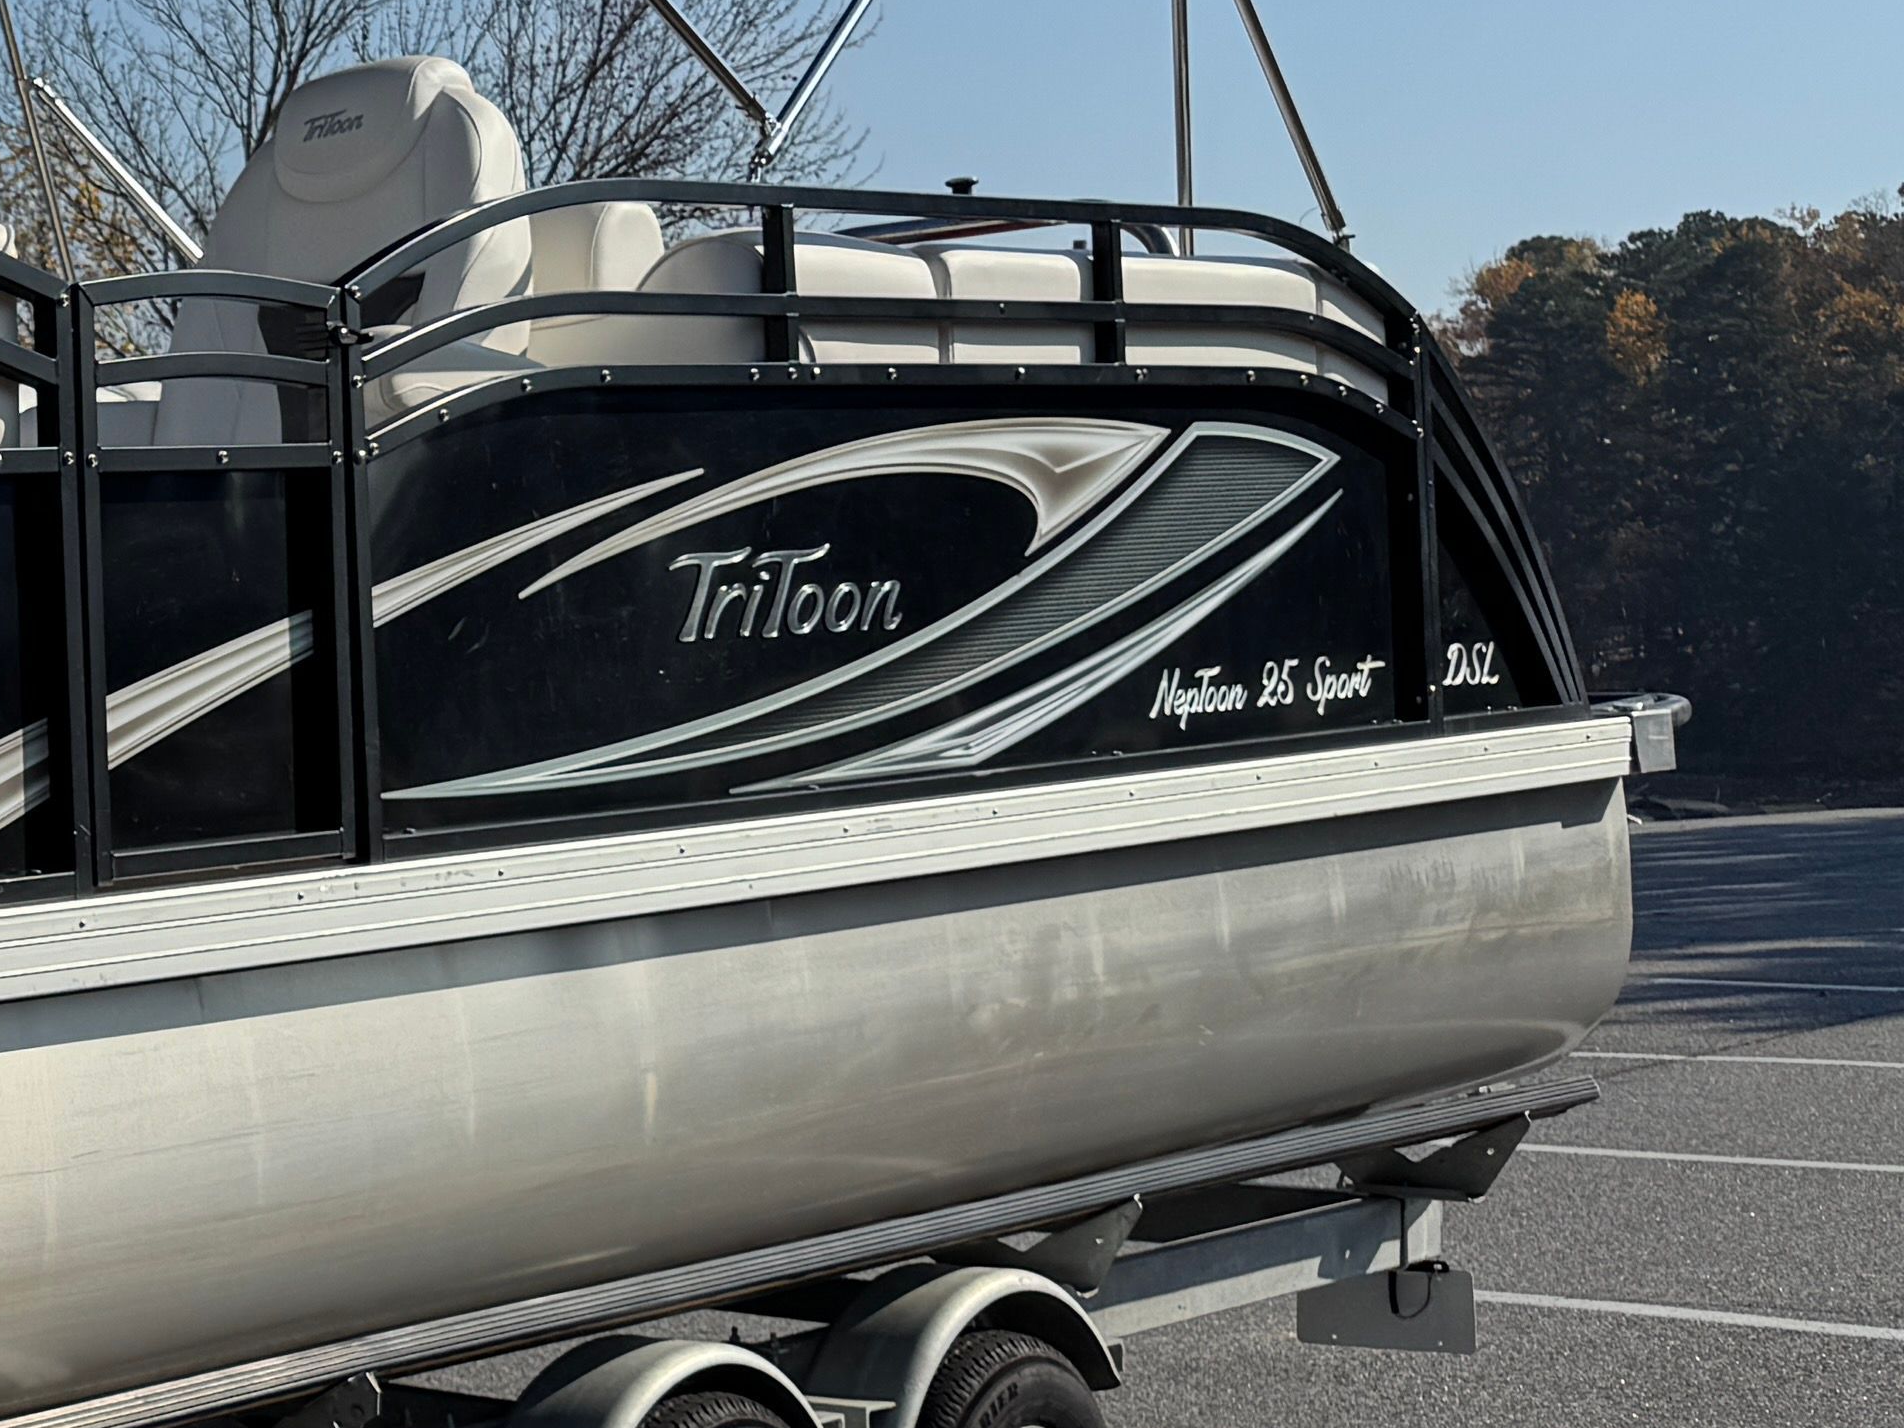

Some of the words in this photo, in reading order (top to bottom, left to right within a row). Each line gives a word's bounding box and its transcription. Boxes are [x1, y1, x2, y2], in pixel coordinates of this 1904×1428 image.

[303, 109, 363, 142] TriToon
[669, 543, 903, 642] TriToon
[1149, 665, 1248, 731] NepToon
[1256, 658, 1300, 708] 25
[1307, 654, 1386, 716] Sport
[1442, 641, 1500, 686] DSL
